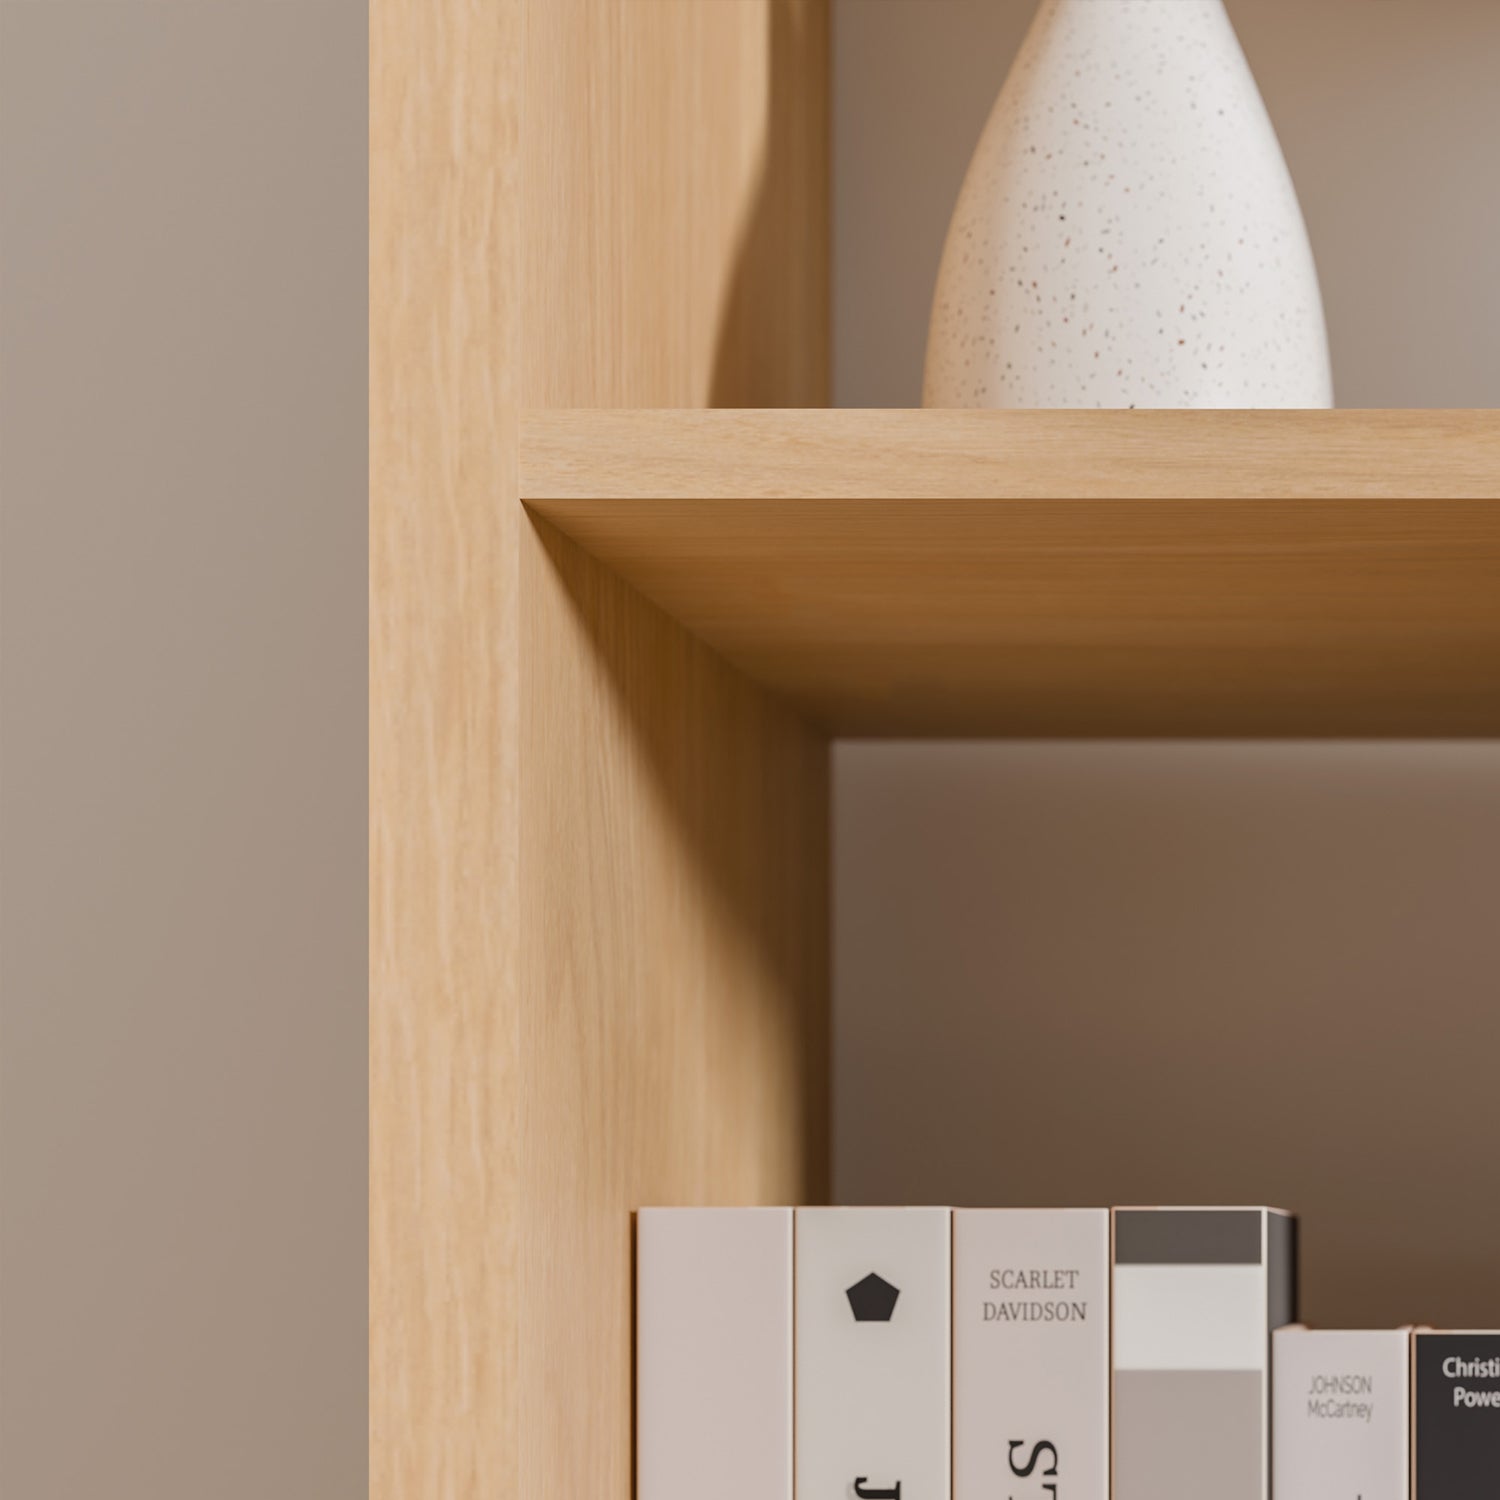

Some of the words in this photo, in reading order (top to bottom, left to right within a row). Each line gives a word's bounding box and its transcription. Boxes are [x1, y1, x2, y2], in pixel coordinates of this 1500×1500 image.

[989, 1268, 1080, 1290] SCARLET
[982, 1301, 1087, 1322] DAVIDSON
[1308, 1374, 1373, 1395] JOHNSON
